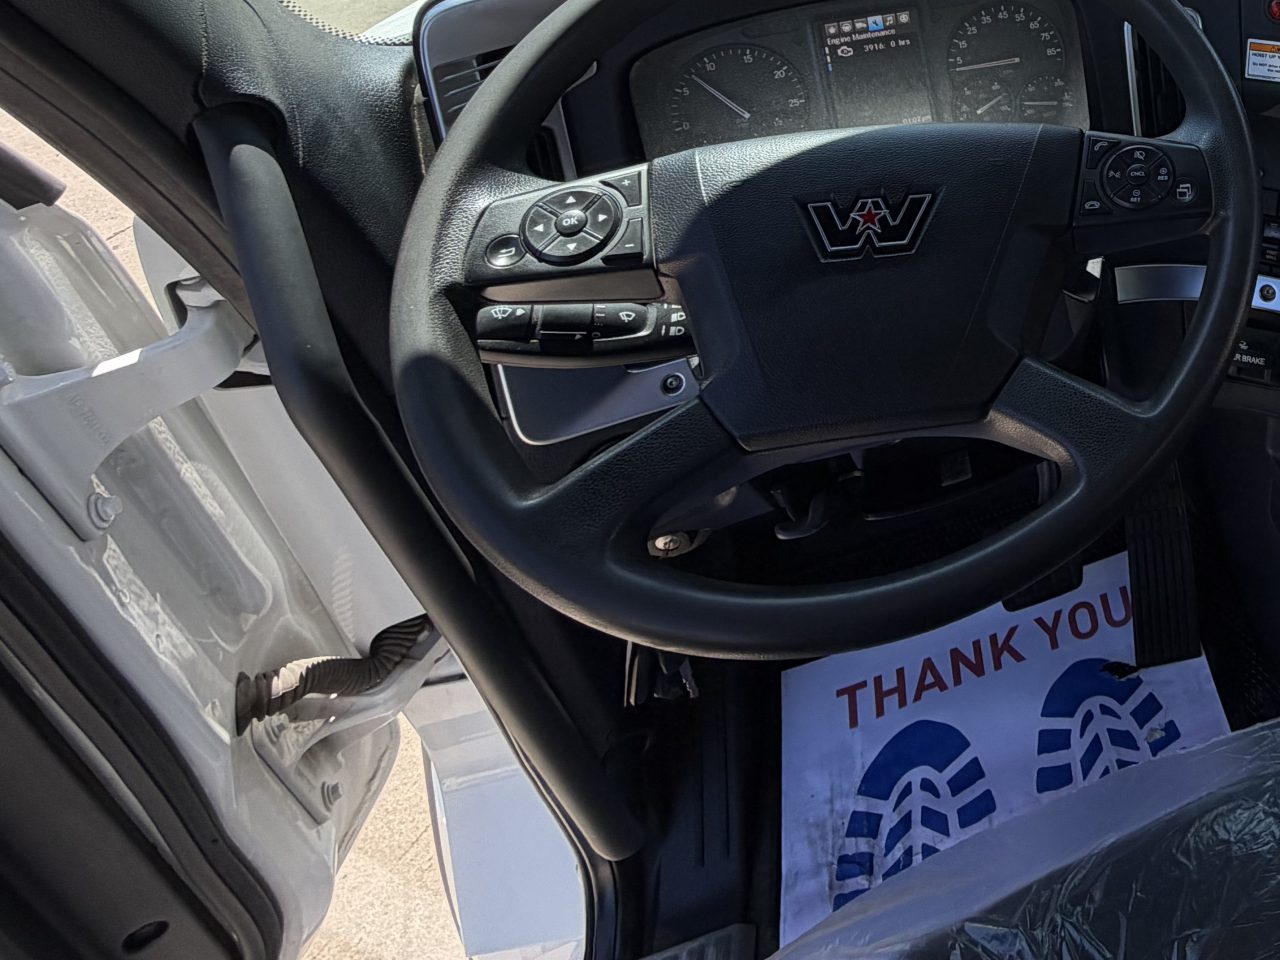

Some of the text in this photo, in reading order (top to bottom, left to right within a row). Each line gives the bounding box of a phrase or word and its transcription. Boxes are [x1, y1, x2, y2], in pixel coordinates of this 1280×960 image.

[998, 11, 1008, 19] 45
[1015, 13, 1025, 21] 55
[981, 16, 992, 24] 35
[1029, 21, 1040, 30] 65
[967, 26, 978, 35] 25
[827, 29, 895, 46] Engine Maintenance
[1040, 32, 1051, 40] 75
[958, 41, 968, 49] 15
[1046, 47, 1056, 55] 85
[743, 55, 753, 63] 15
[956, 56, 963, 65] 5
[706, 63, 716, 71] 10
[773, 69, 786, 78] 20
[682, 87, 690, 96] 5
[788, 98, 799, 107] 25
[682, 121, 690, 130] 0
[562, 216, 579, 227] OK
[1242, 355, 1266, 366] BRAKE
[835, 586, 1133, 729] THANK YOU
